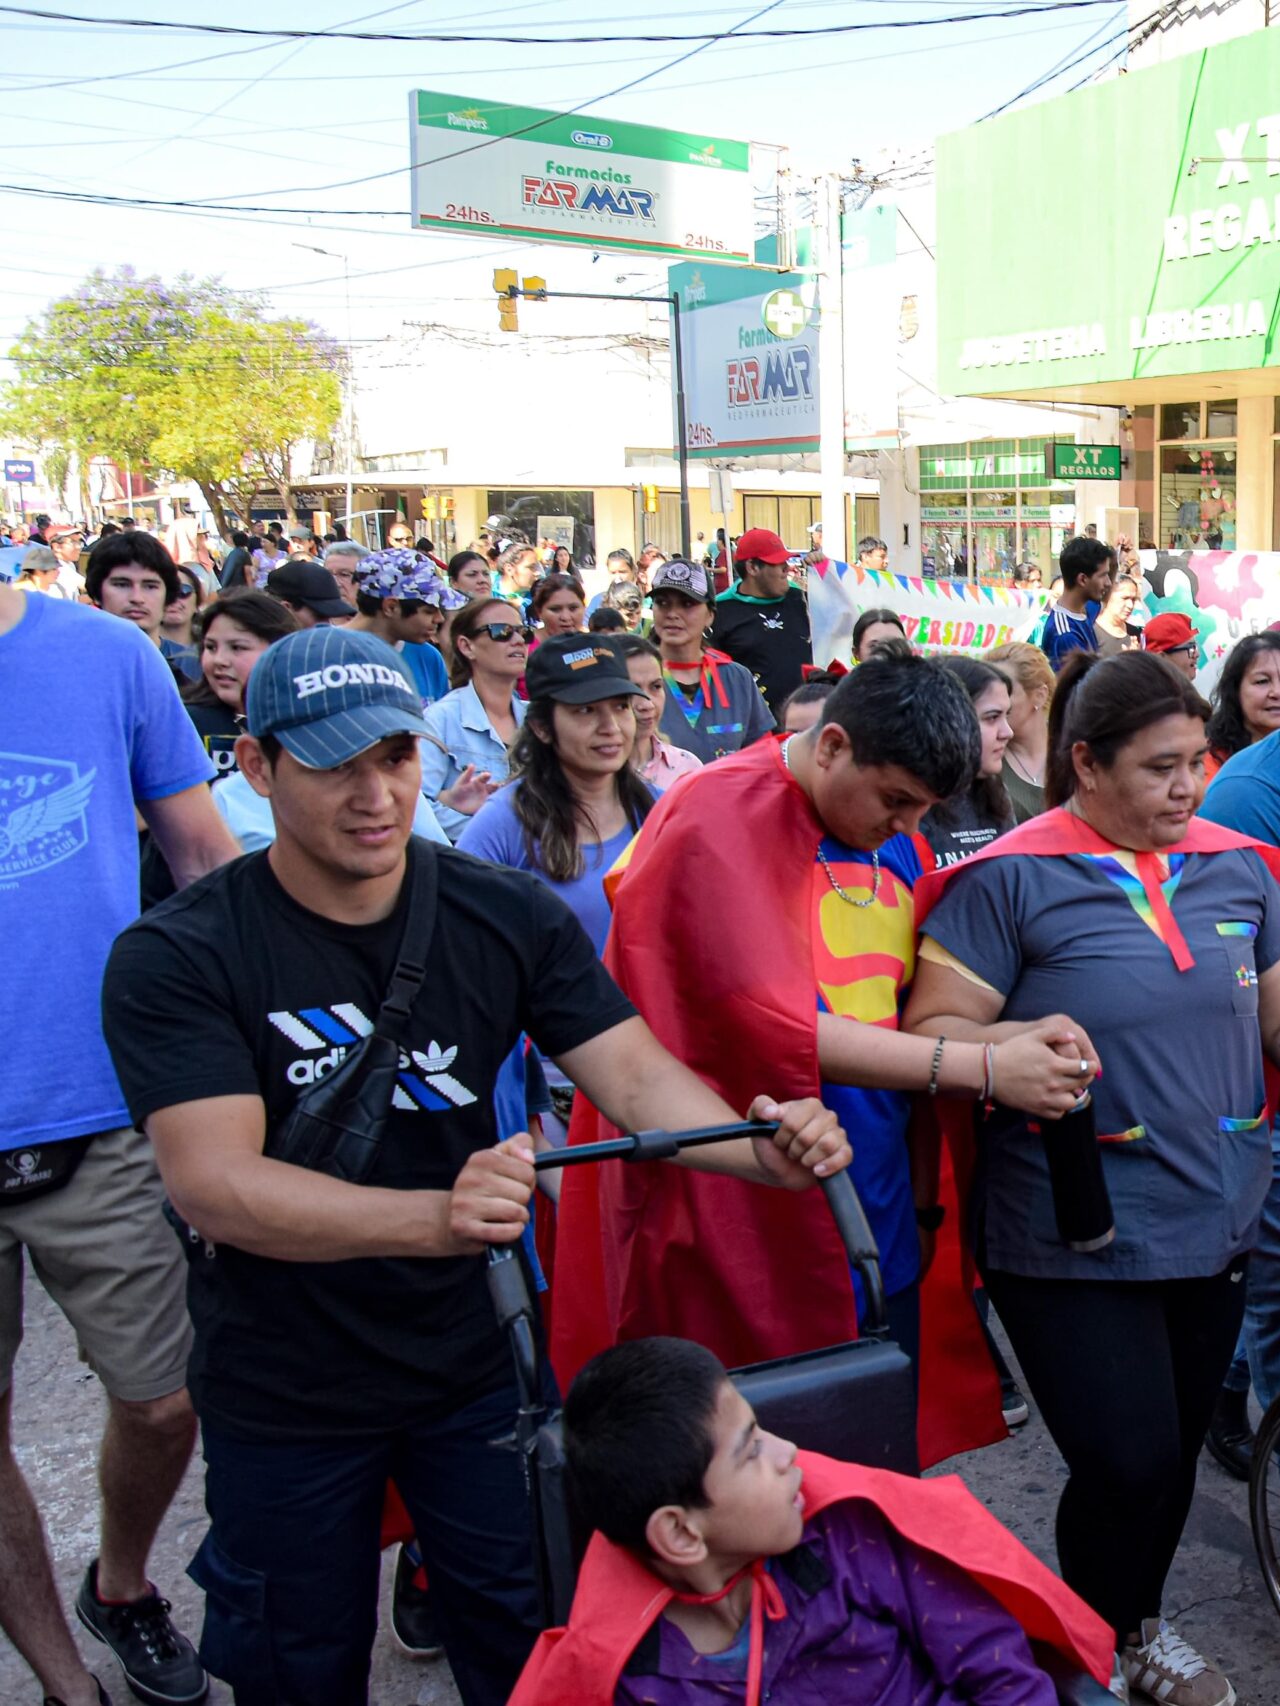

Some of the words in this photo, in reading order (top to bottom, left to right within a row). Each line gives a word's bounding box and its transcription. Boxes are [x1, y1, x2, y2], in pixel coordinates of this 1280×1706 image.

[574, 133, 611, 147] Oral-B
[546, 160, 632, 185] Farmacias
[521, 175, 656, 222] FARMAR
[445, 203, 496, 223] 24hs.
[685, 233, 728, 250] 24hs.
[1130, 299, 1267, 350] LIBRERIA
[1073, 447, 1103, 465] XT
[1060, 465, 1116, 476] REGALOS
[899, 615, 1014, 648] VERSIDADES
[293, 663, 414, 699] HONDA
[287, 1045, 411, 1086] adis
